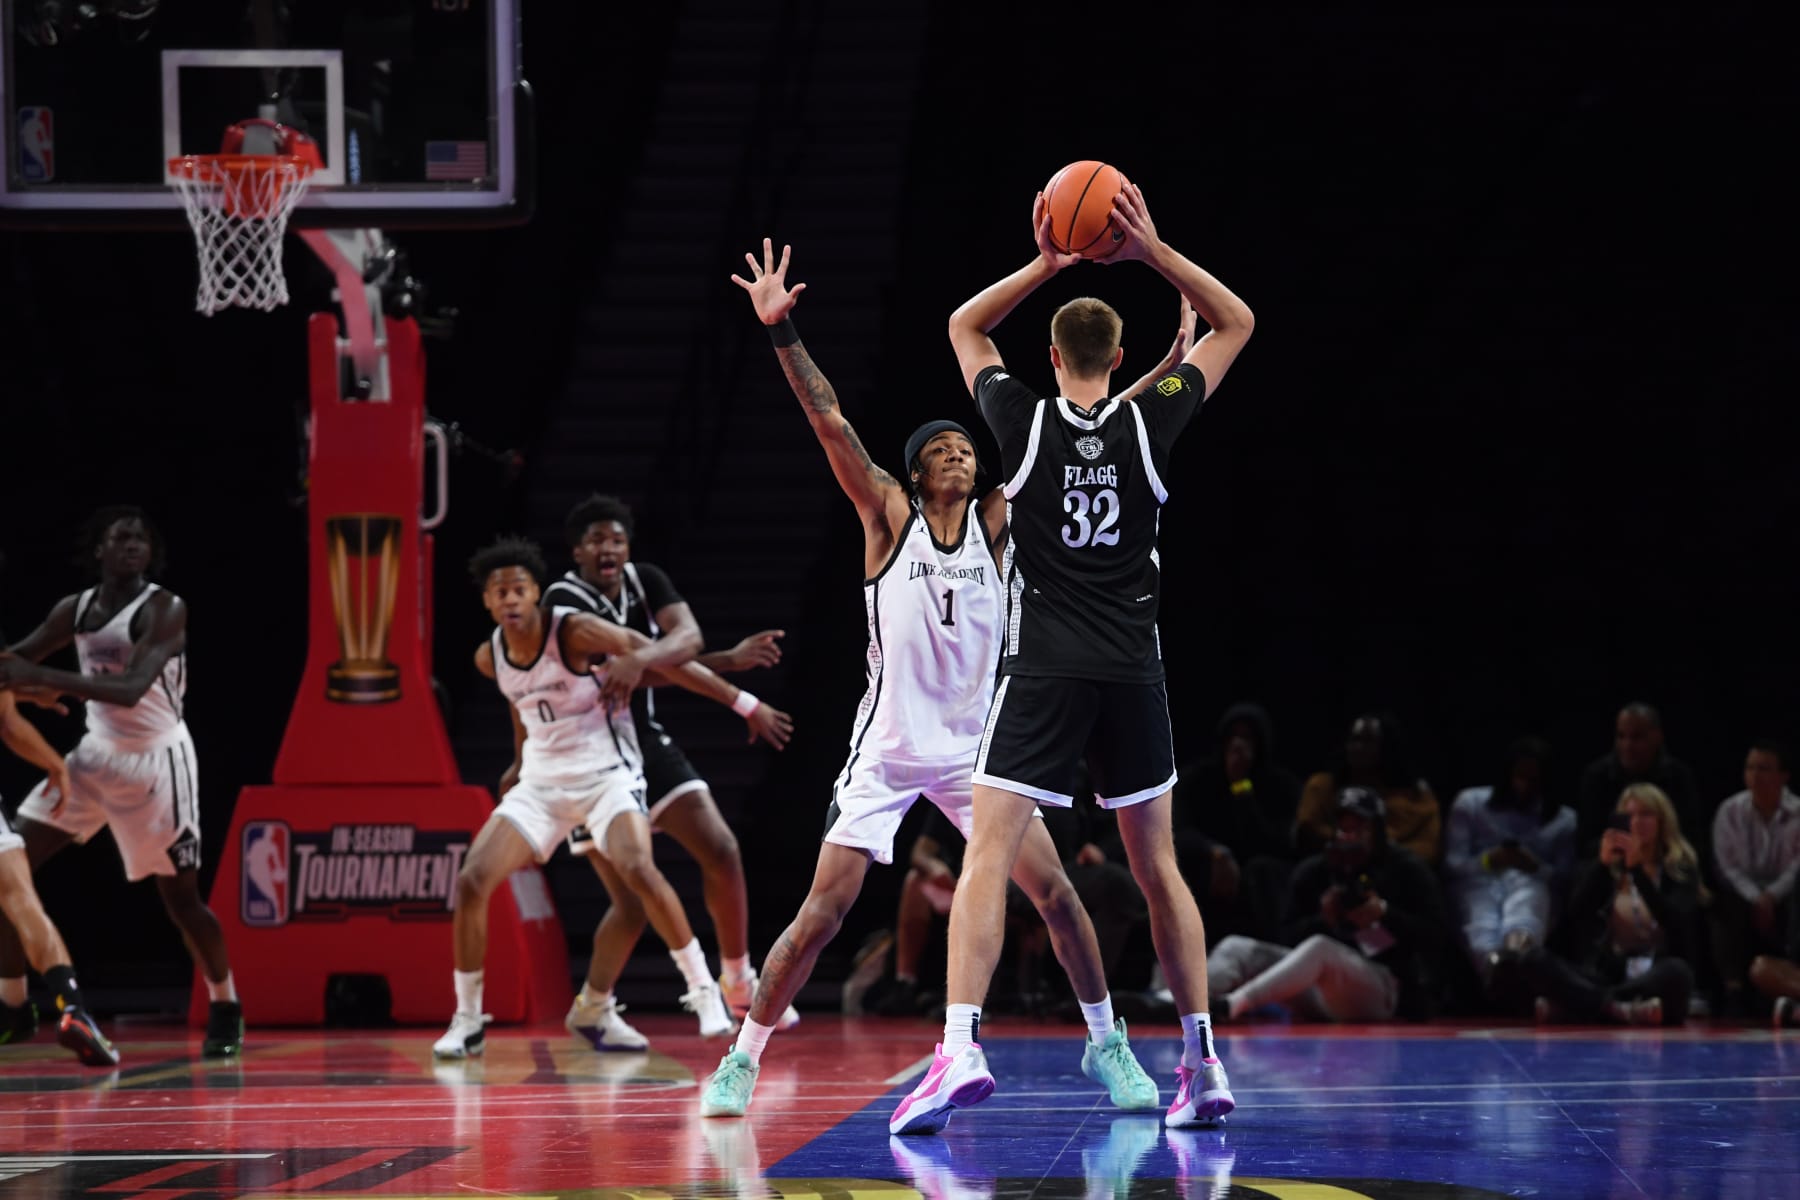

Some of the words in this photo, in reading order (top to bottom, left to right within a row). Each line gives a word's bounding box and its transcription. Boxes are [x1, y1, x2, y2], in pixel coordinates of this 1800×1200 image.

[1063, 464, 1118, 489] FLAGG
[1061, 488, 1121, 548] 32
[908, 561, 936, 581] LINK
[937, 566, 985, 586] ACADEMY
[940, 588, 955, 627] 1
[537, 699, 556, 723] 0
[331, 826, 415, 853] IN-SEASON
[294, 843, 469, 912] TOURNAMENT
